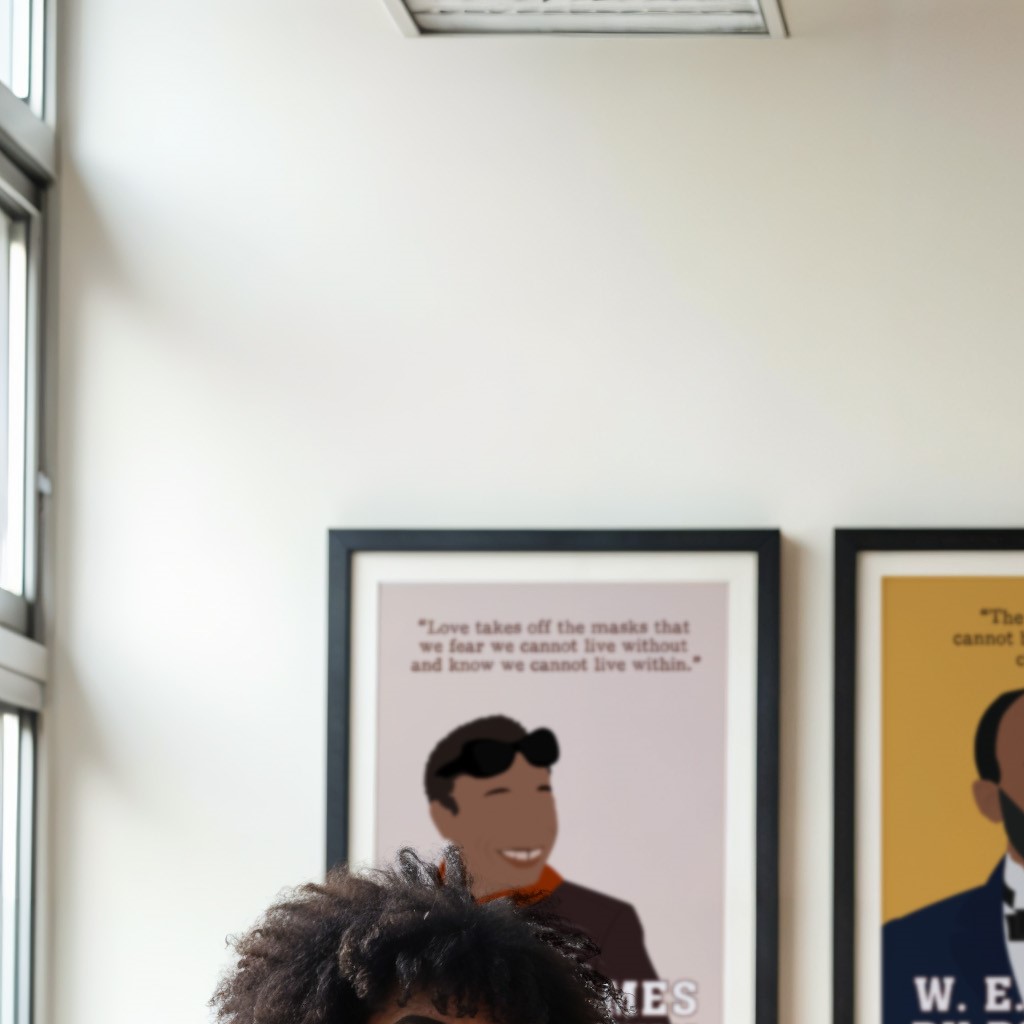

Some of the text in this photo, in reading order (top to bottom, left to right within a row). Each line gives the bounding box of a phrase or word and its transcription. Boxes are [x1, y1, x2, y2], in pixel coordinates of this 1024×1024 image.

[980, 607, 1024, 626] "The
[418, 618, 690, 635] "Love takes off the masks that
[419, 637, 688, 654] we fear we cannot live without
[953, 630, 1013, 647] cannot
[411, 655, 702, 673] and know we cannot live within."
[605, 980, 698, 1017] MES
[914, 976, 967, 1012] W.
[985, 976, 1024, 1012] E.
